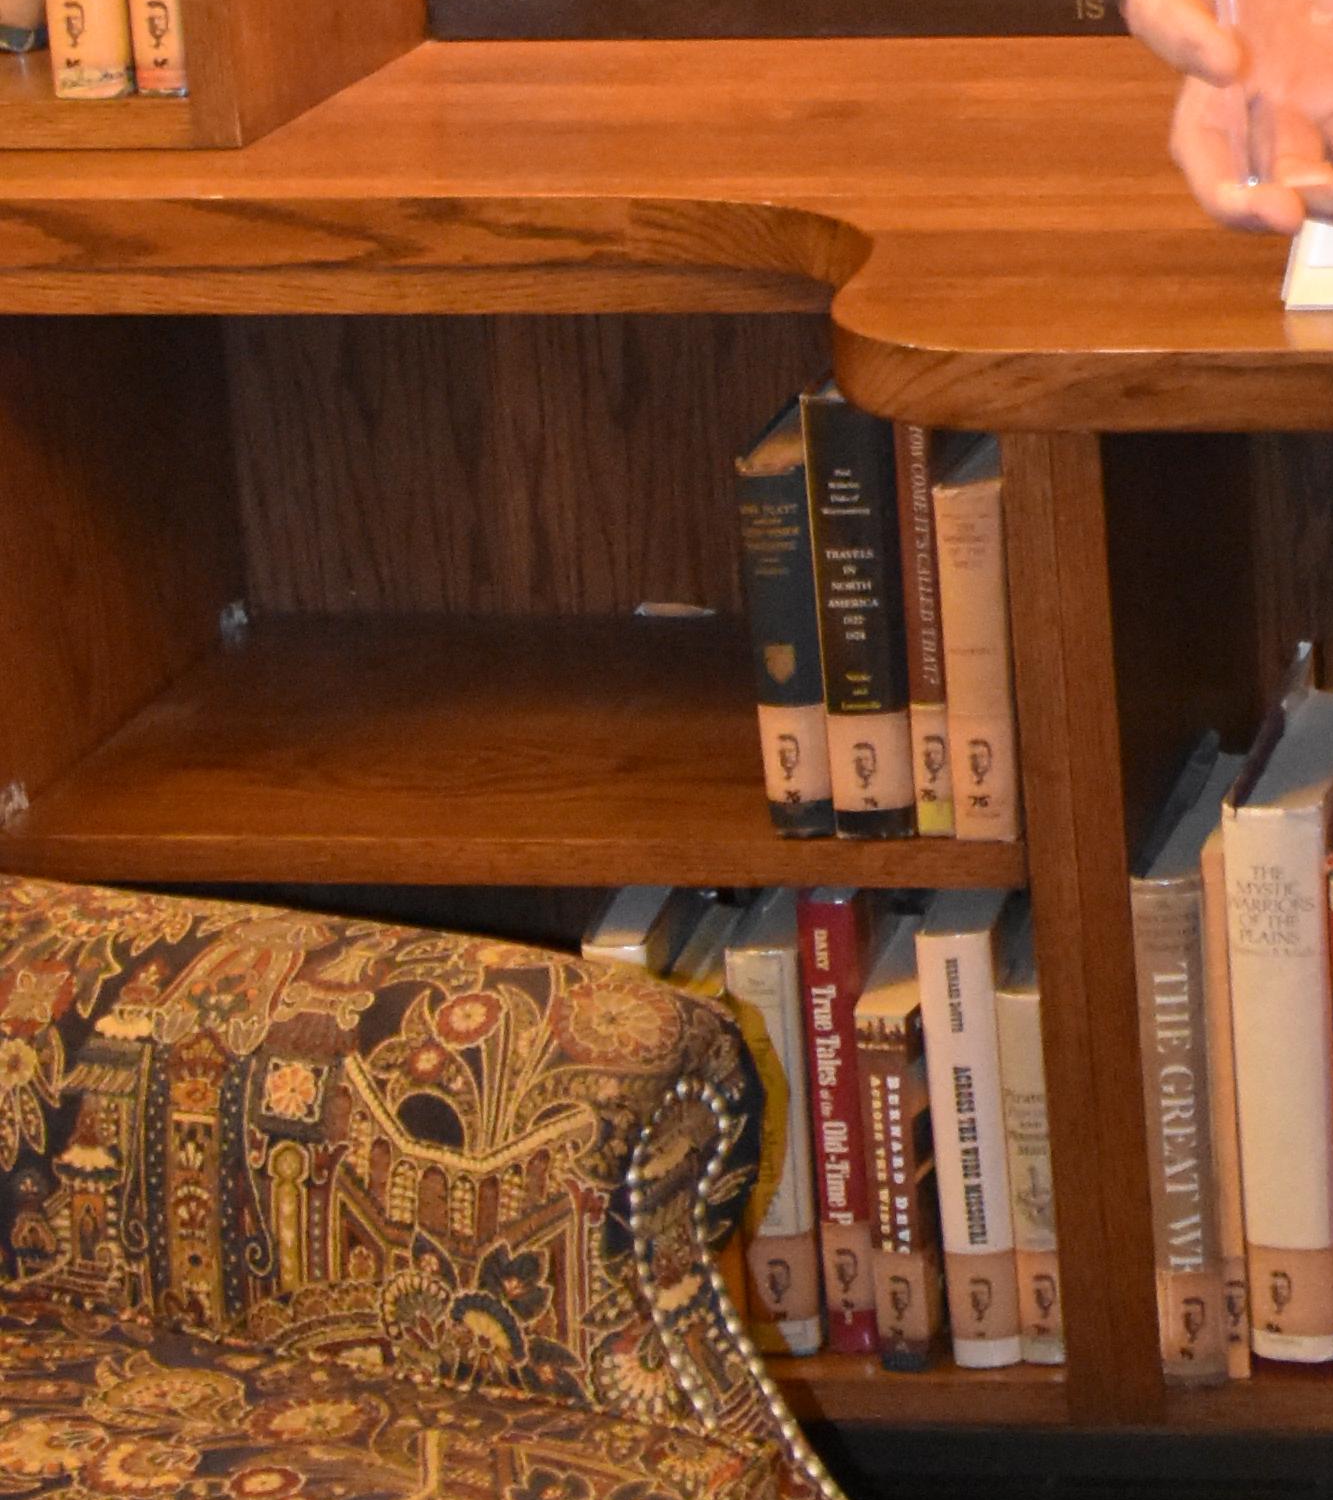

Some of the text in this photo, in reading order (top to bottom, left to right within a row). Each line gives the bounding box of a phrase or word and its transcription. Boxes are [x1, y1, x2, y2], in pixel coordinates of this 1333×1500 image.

[825, 549, 875, 560] TRAVELS
[827, 598, 880, 609] AMERICA
[812, 983, 842, 1087] True Tales
[954, 1066, 975, 1115] ACROSS
[1153, 961, 1201, 1202] THE GREAT
